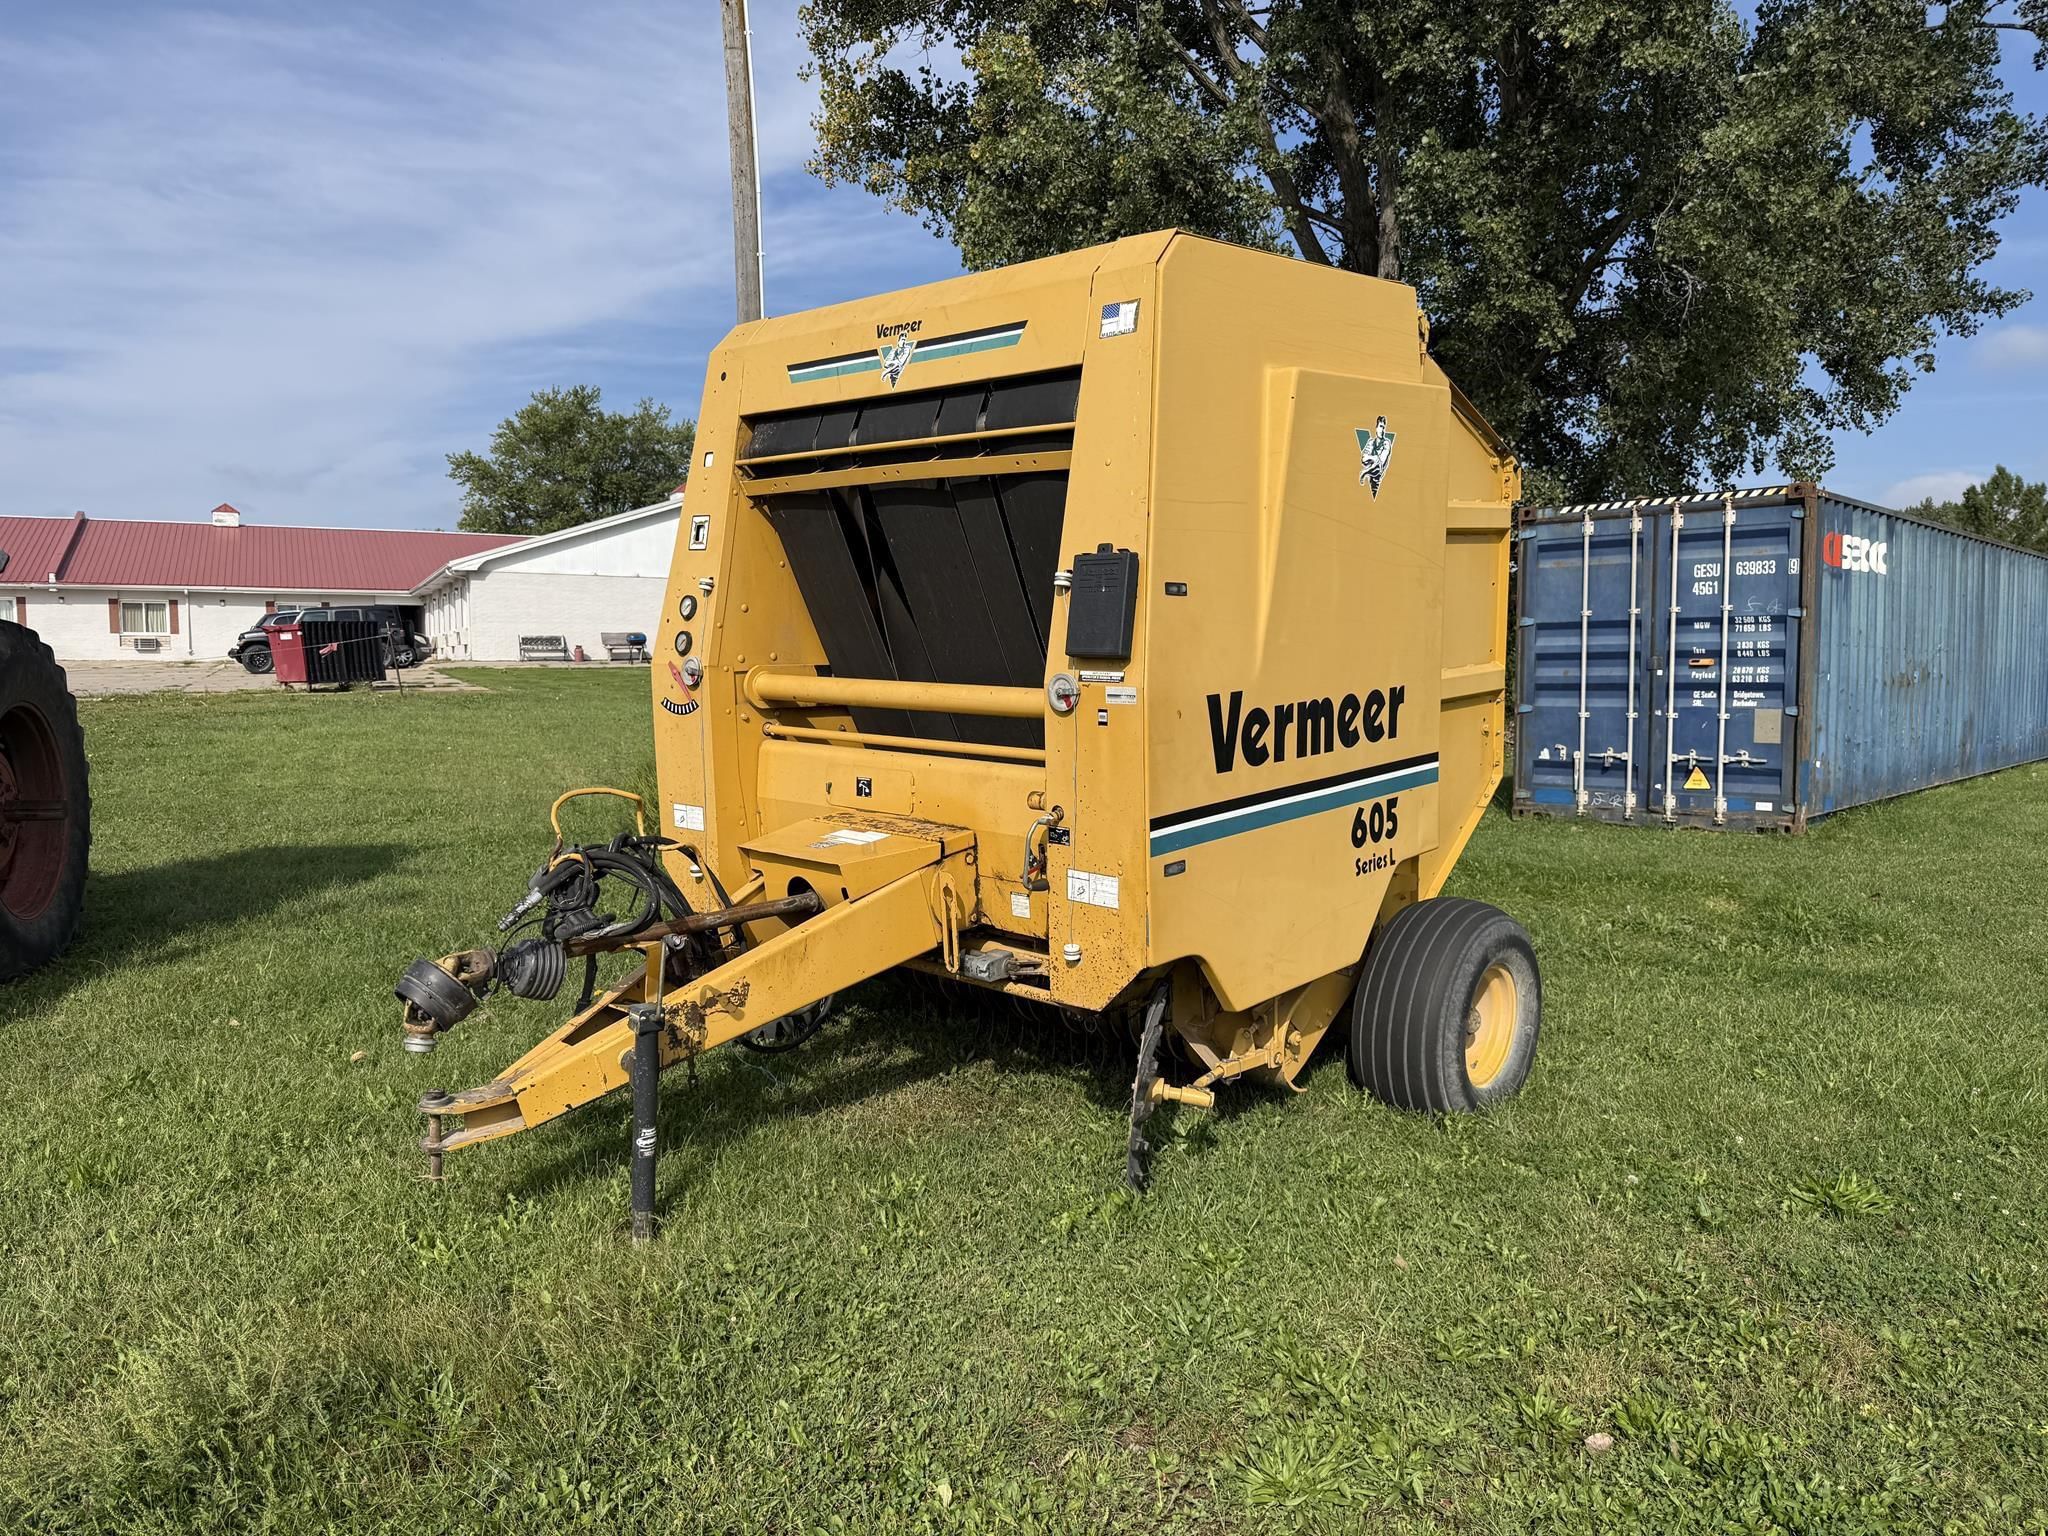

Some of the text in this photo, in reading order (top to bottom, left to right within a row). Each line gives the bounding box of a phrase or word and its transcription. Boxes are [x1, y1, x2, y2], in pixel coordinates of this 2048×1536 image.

[877, 320, 922, 338] Vermeer
[1694, 560, 1798, 578] GESU 639833 9
[1692, 581, 1718, 596] 45G1
[1758, 615, 1771, 623] KGS
[1759, 624, 1772, 632] LBS
[1757, 640, 1770, 648] KGS
[1691, 671, 1716, 680] Payload
[1757, 666, 1770, 674] KGS
[1756, 675, 1769, 683] LBS
[1207, 685, 1404, 774] Vermeer
[1351, 797, 1398, 848] 605
[1356, 848, 1395, 876] Series L
